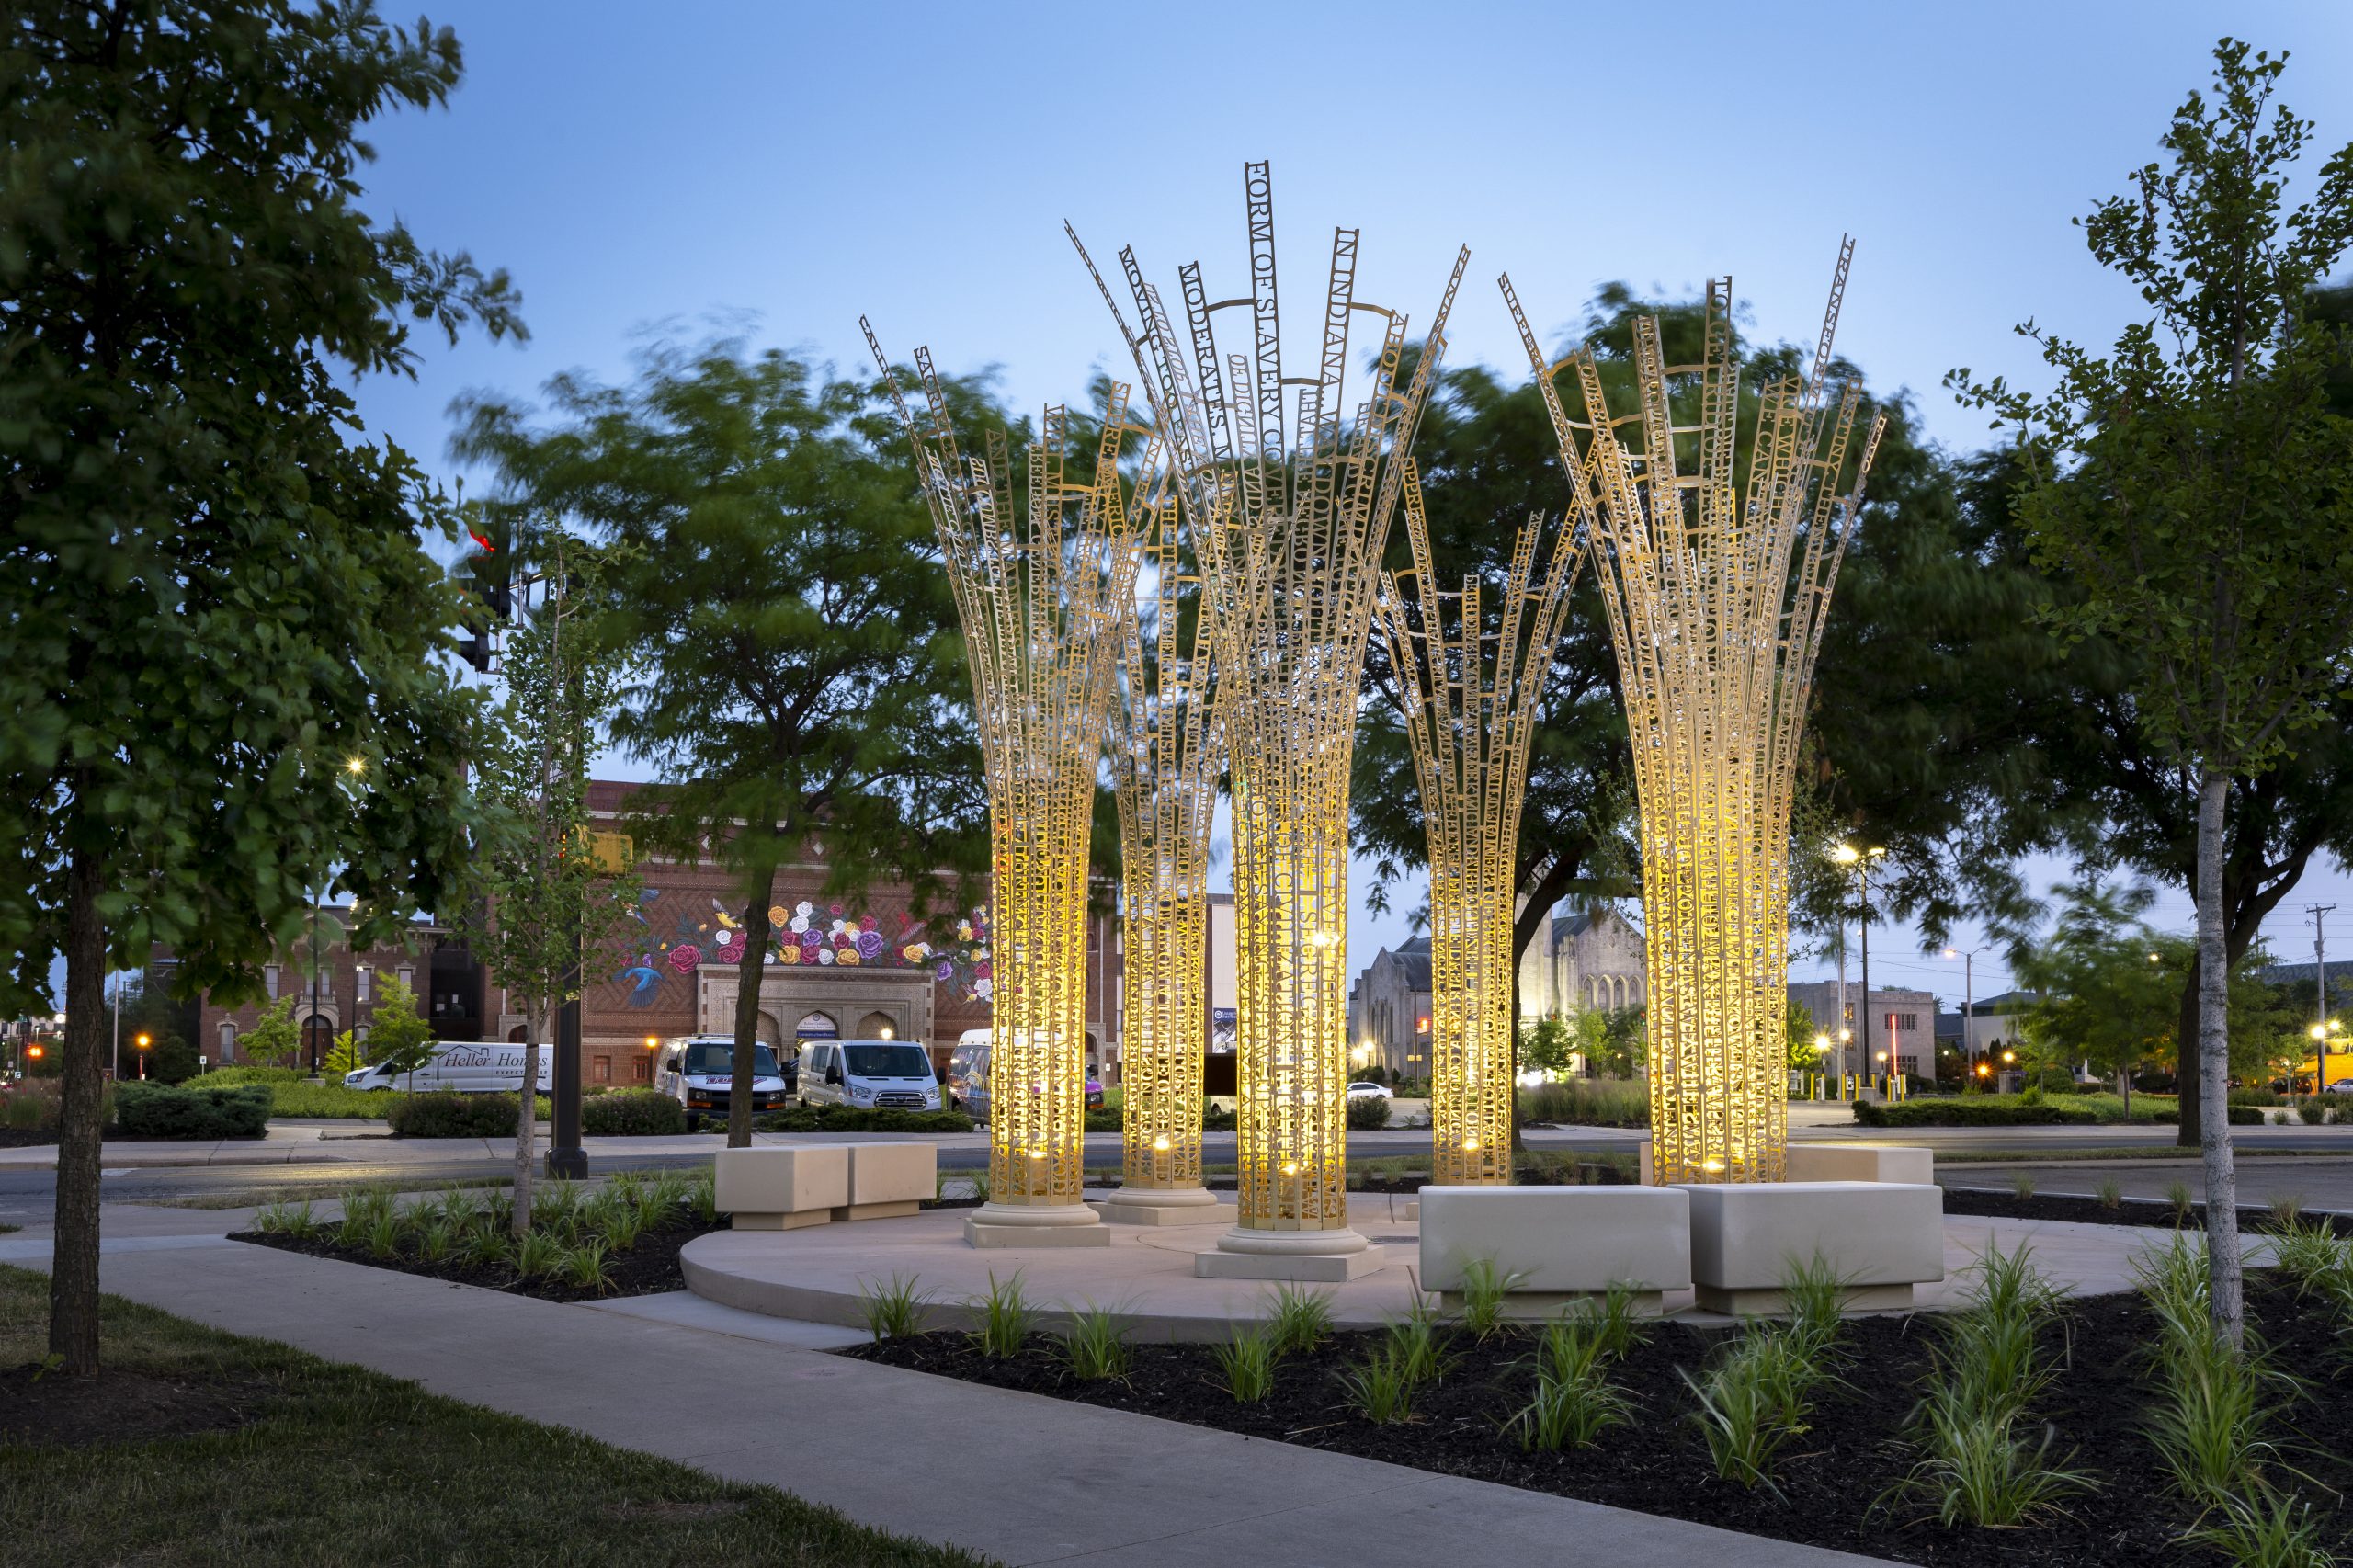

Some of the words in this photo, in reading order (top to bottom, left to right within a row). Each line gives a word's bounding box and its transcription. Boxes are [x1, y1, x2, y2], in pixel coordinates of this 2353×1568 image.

[1246, 163, 1272, 244] FORM
[1336, 230, 1357, 257] IN
[1253, 252, 1275, 290] OF
[1708, 277, 1730, 312] TO
[1120, 245, 1163, 356] MOVING
[1809, 234, 1853, 397] TRANSFORM
[1181, 261, 1230, 439] MODERATES.
[1256, 297, 1280, 421] SLAVERY
[1375, 309, 1406, 401] ABOUT
[1705, 317, 1728, 369] GET
[1154, 356, 1177, 409] TOO
[1760, 379, 1780, 424] WE
[988, 428, 1006, 475] AND
[1770, 433, 1793, 513] WHICH
[994, 484, 1012, 534] THE
[1042, 471, 1062, 537] MUST
[1263, 428, 1287, 551] COVERED
[1161, 497, 1177, 536] THE
[1308, 476, 1333, 559] DOWN
[1161, 541, 1176, 590] TIME
[998, 538, 1021, 647] MADNESS
[1251, 761, 1268, 817] WHO
[1253, 827, 1269, 874] ARE
[1275, 832, 1293, 863] OF
[1238, 846, 1250, 914] SLOW
[1253, 883, 1269, 976] SAYING
[1275, 873, 1293, 1046] CIVILIZATION
[1239, 971, 1250, 1007] WE
[1300, 911, 1318, 1092] SEGREGATION
[1657, 941, 1674, 1058] CAPACITY
[1014, 994, 1028, 1038] ARE
[445, 1053, 491, 1067] Heller
[1054, 1040, 1067, 1085] MEN
[1239, 1020, 1250, 1085] LOVE
[1276, 1084, 1293, 1121] TO
[1300, 1103, 1318, 1125] IS
[1300, 1133, 1318, 1148] A
